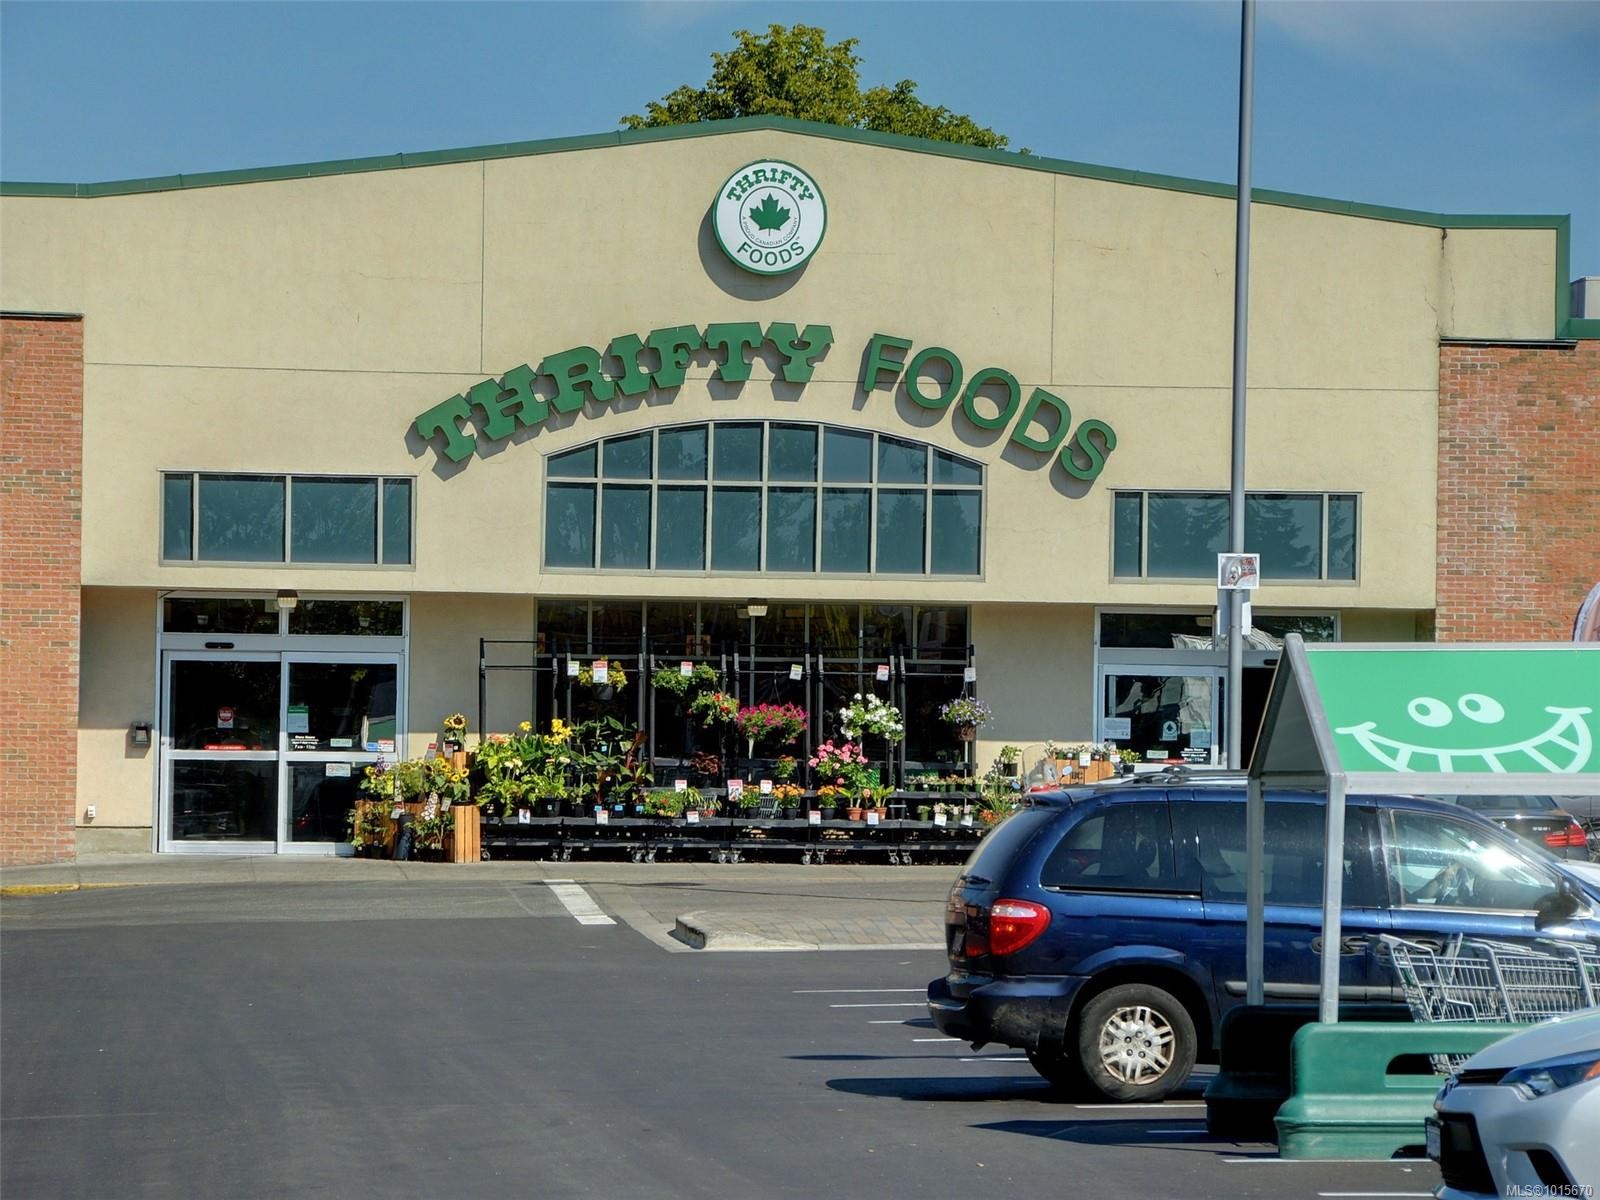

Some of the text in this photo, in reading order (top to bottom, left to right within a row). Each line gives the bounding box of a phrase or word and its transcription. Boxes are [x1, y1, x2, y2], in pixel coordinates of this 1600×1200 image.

[726, 168, 815, 201] THRIFTY
[755, 238, 783, 246] CANADIAN
[783, 217, 798, 241] COMPANY
[737, 241, 805, 266] FOODS
[415, 321, 1118, 481] THRIFTY FOODS
